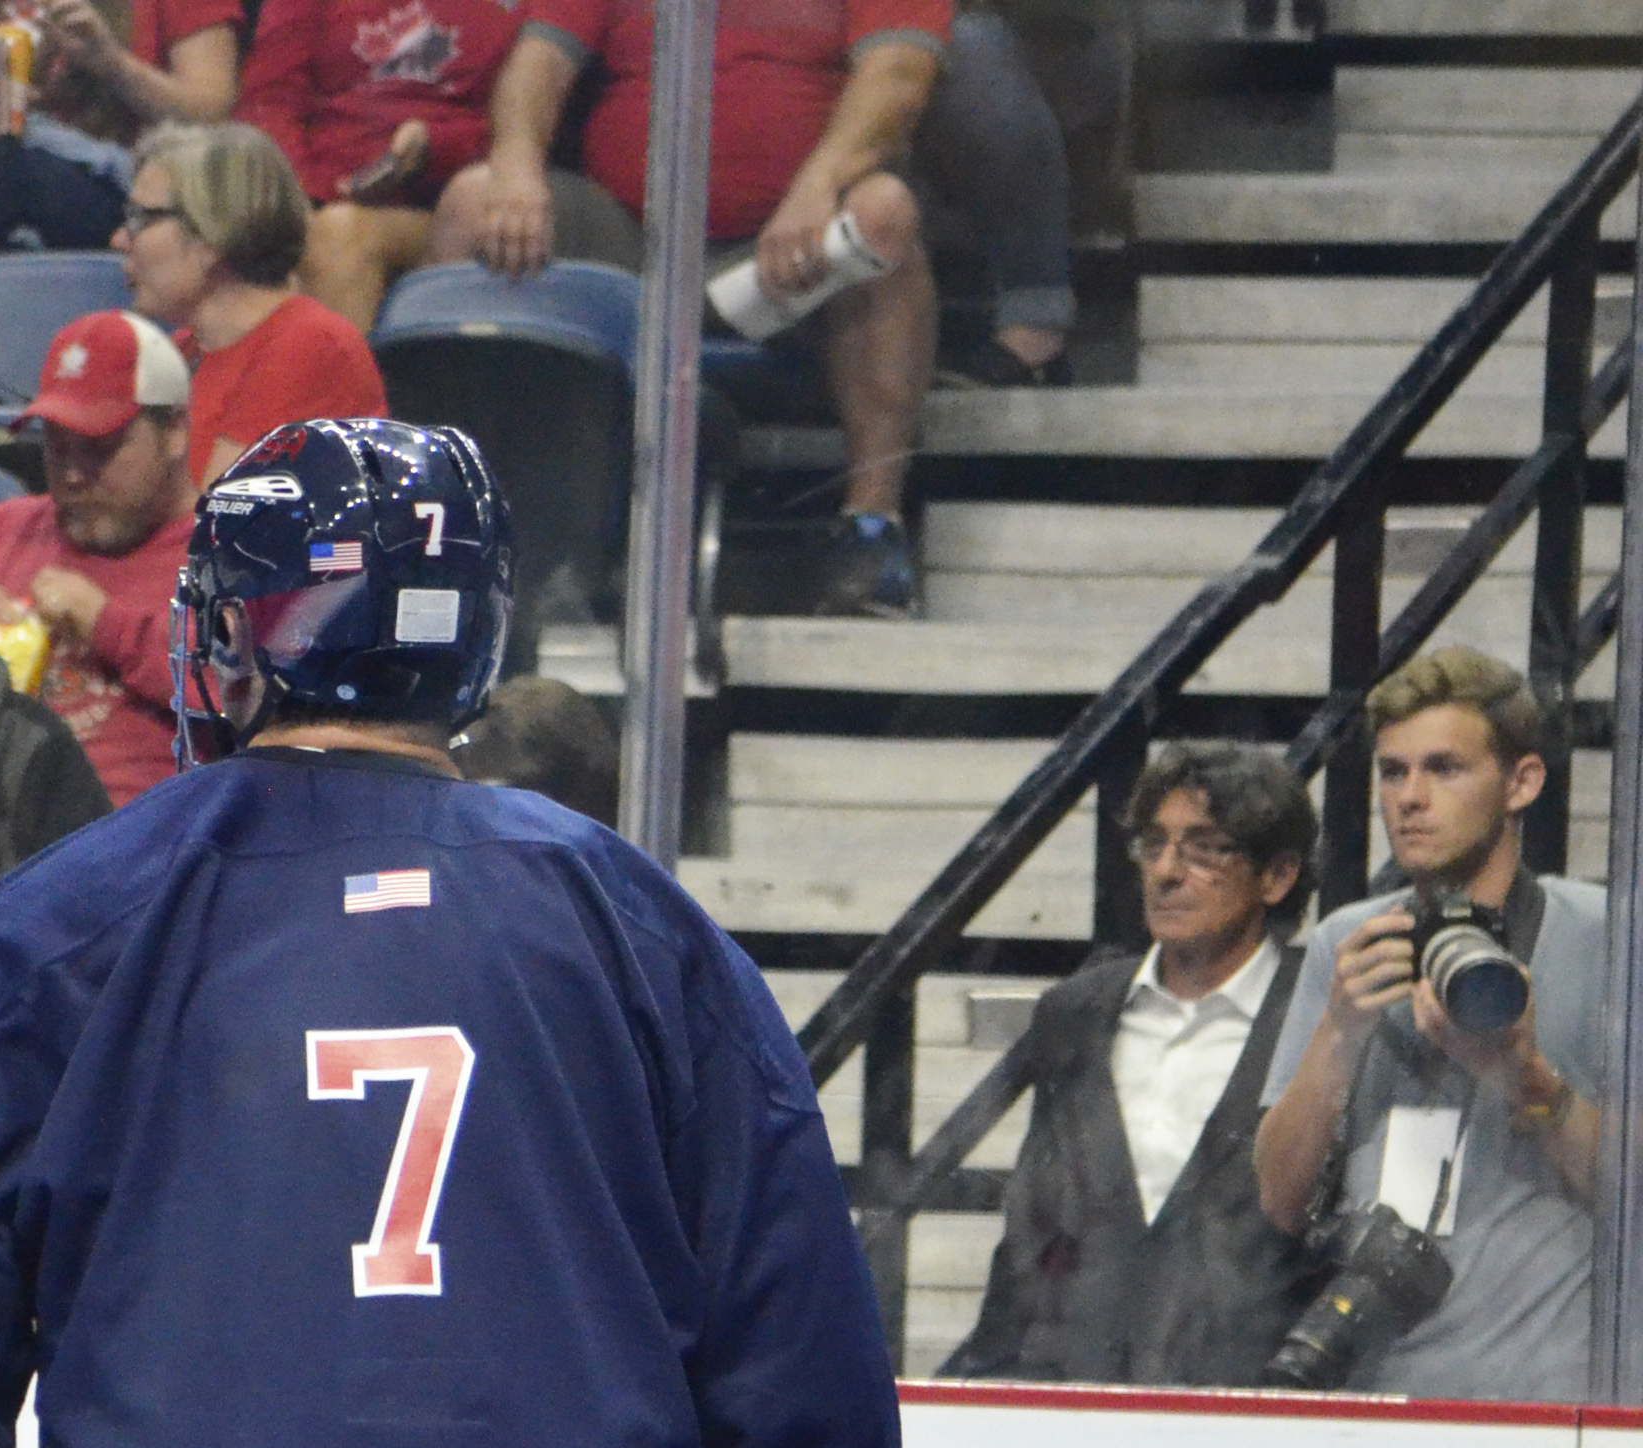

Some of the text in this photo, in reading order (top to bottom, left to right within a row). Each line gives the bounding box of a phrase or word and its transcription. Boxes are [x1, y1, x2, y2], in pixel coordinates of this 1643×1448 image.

[206, 498, 255, 517] BAUER
[414, 502, 445, 557] 7
[303, 1024, 478, 1300] 7
